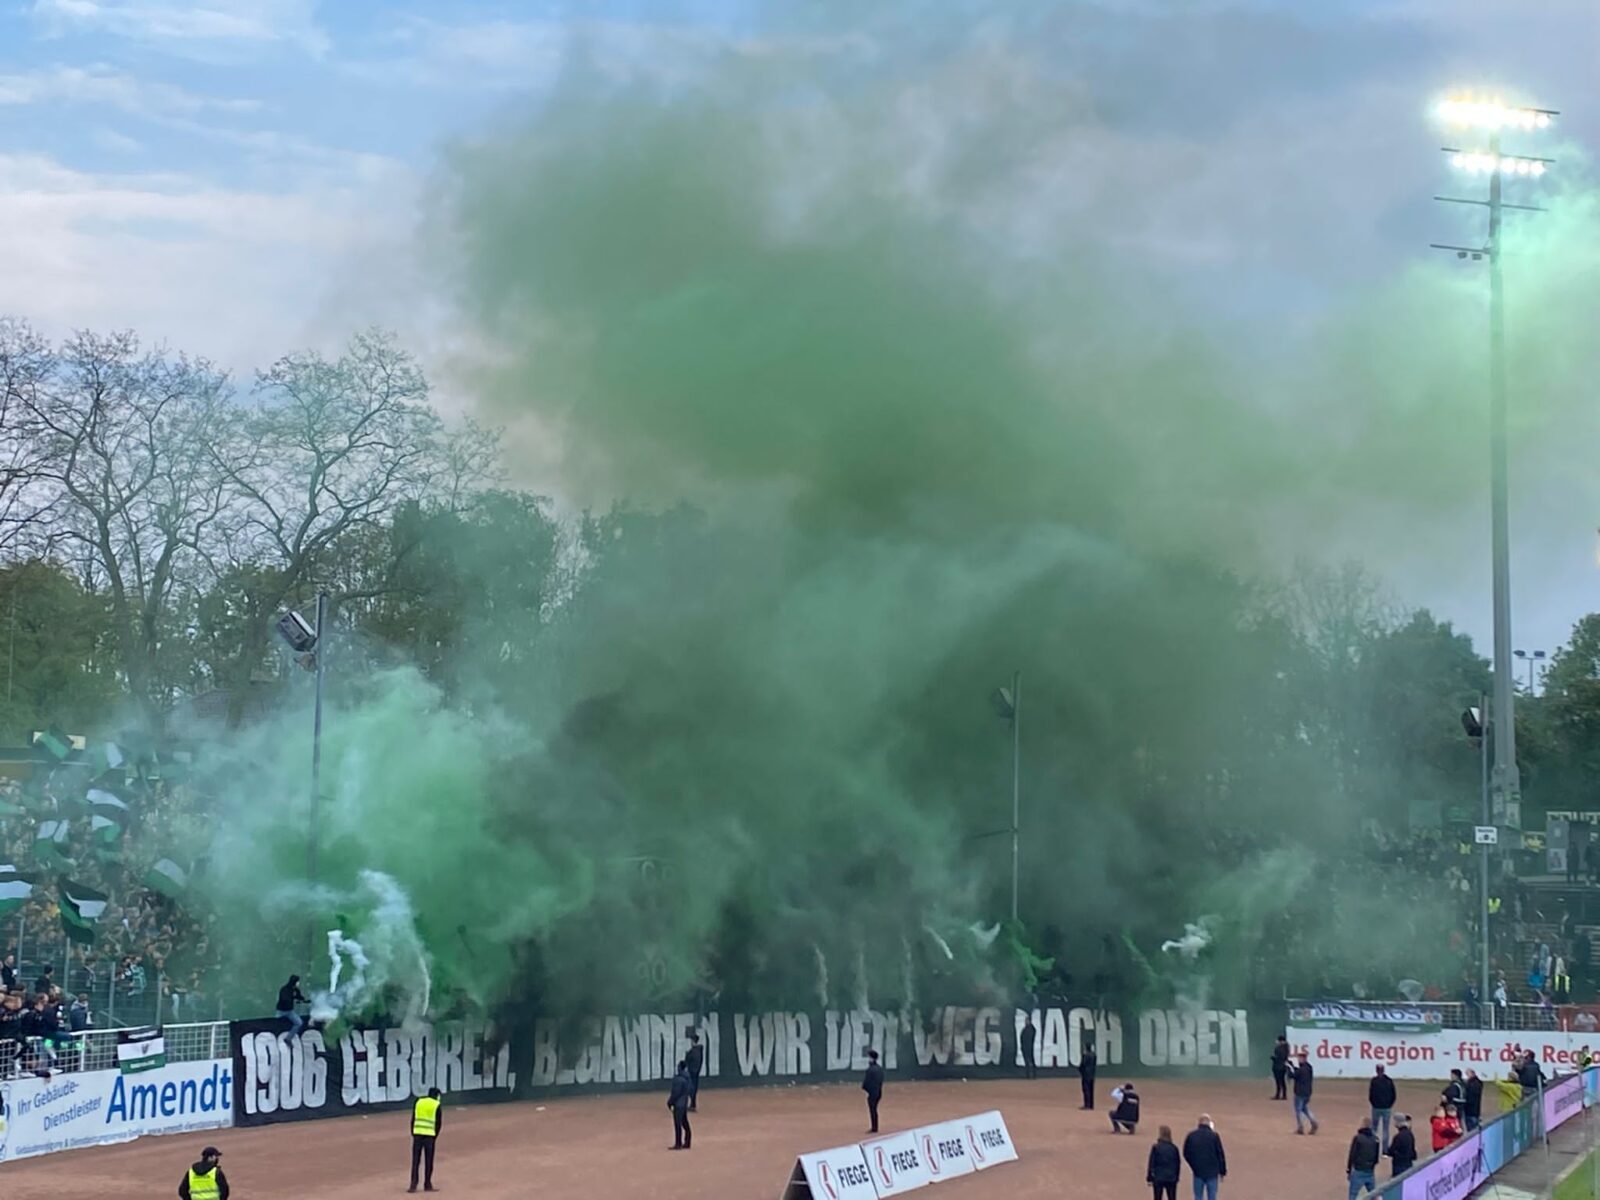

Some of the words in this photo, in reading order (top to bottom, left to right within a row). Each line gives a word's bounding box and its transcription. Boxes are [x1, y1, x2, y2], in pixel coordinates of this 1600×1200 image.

[241, 1028, 327, 1114] 1906
[734, 1011, 811, 1076] WIR
[825, 1009, 898, 1070] DEN
[913, 1005, 1002, 1065] WEG
[1015, 1007, 1123, 1067] NACH
[1139, 1008, 1249, 1067] OBEN
[1317, 1039, 1353, 1059] der
[1360, 1040, 1435, 1066] Region
[1457, 1042, 1492, 1062] für
[17, 1099, 31, 1116] Ihr
[33, 1081, 79, 1108] Gebäude-
[106, 1063, 231, 1124] Amendt
[43, 1096, 102, 1131] Dienstleister
[938, 1138, 965, 1160] FIEGE
[980, 1128, 1005, 1149] FIEGE
[890, 1149, 919, 1173] FIEGE
[837, 1164, 869, 1188] FIEGE
